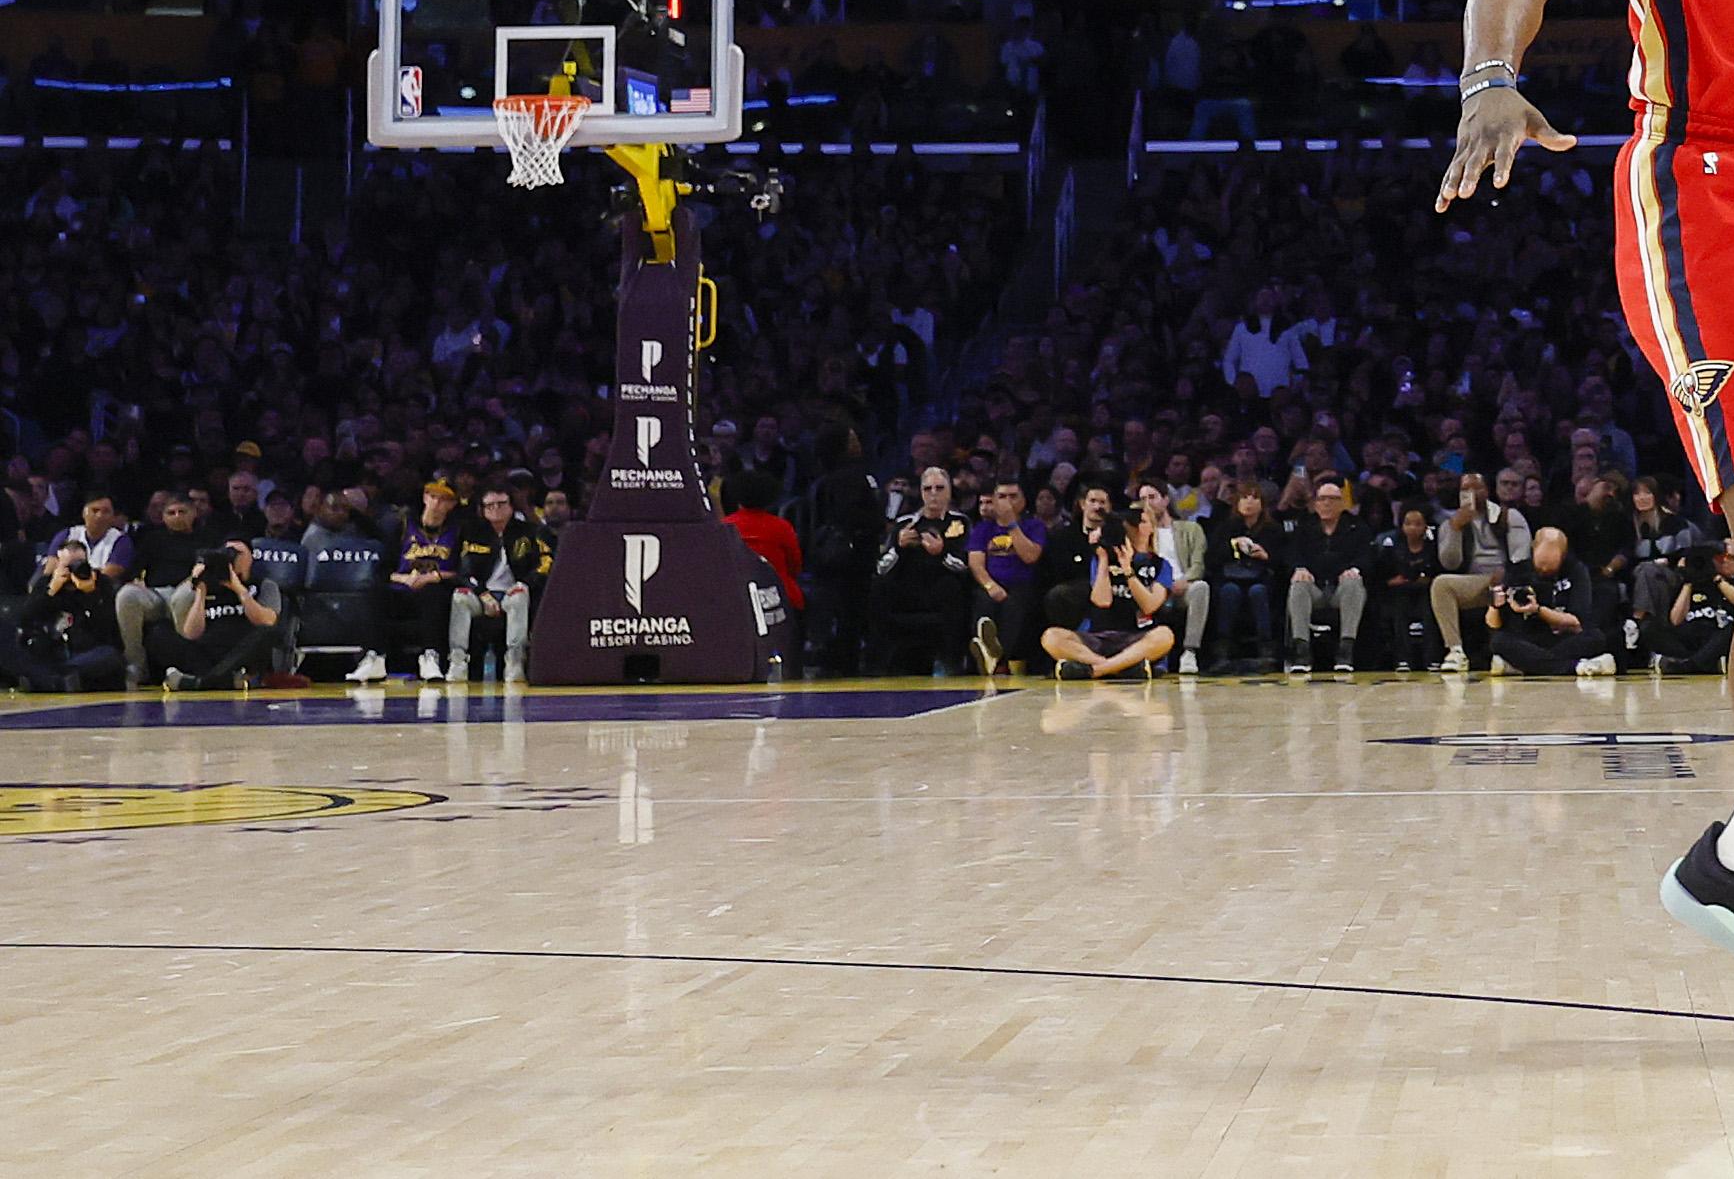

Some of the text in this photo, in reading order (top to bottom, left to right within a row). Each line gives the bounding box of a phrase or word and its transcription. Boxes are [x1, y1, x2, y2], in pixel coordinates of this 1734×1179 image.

[611, 469, 683, 481] PECHANGA
[253, 548, 298, 562] DELTA
[333, 550, 380, 563] DELTA
[590, 617, 690, 635] PECHANGA
